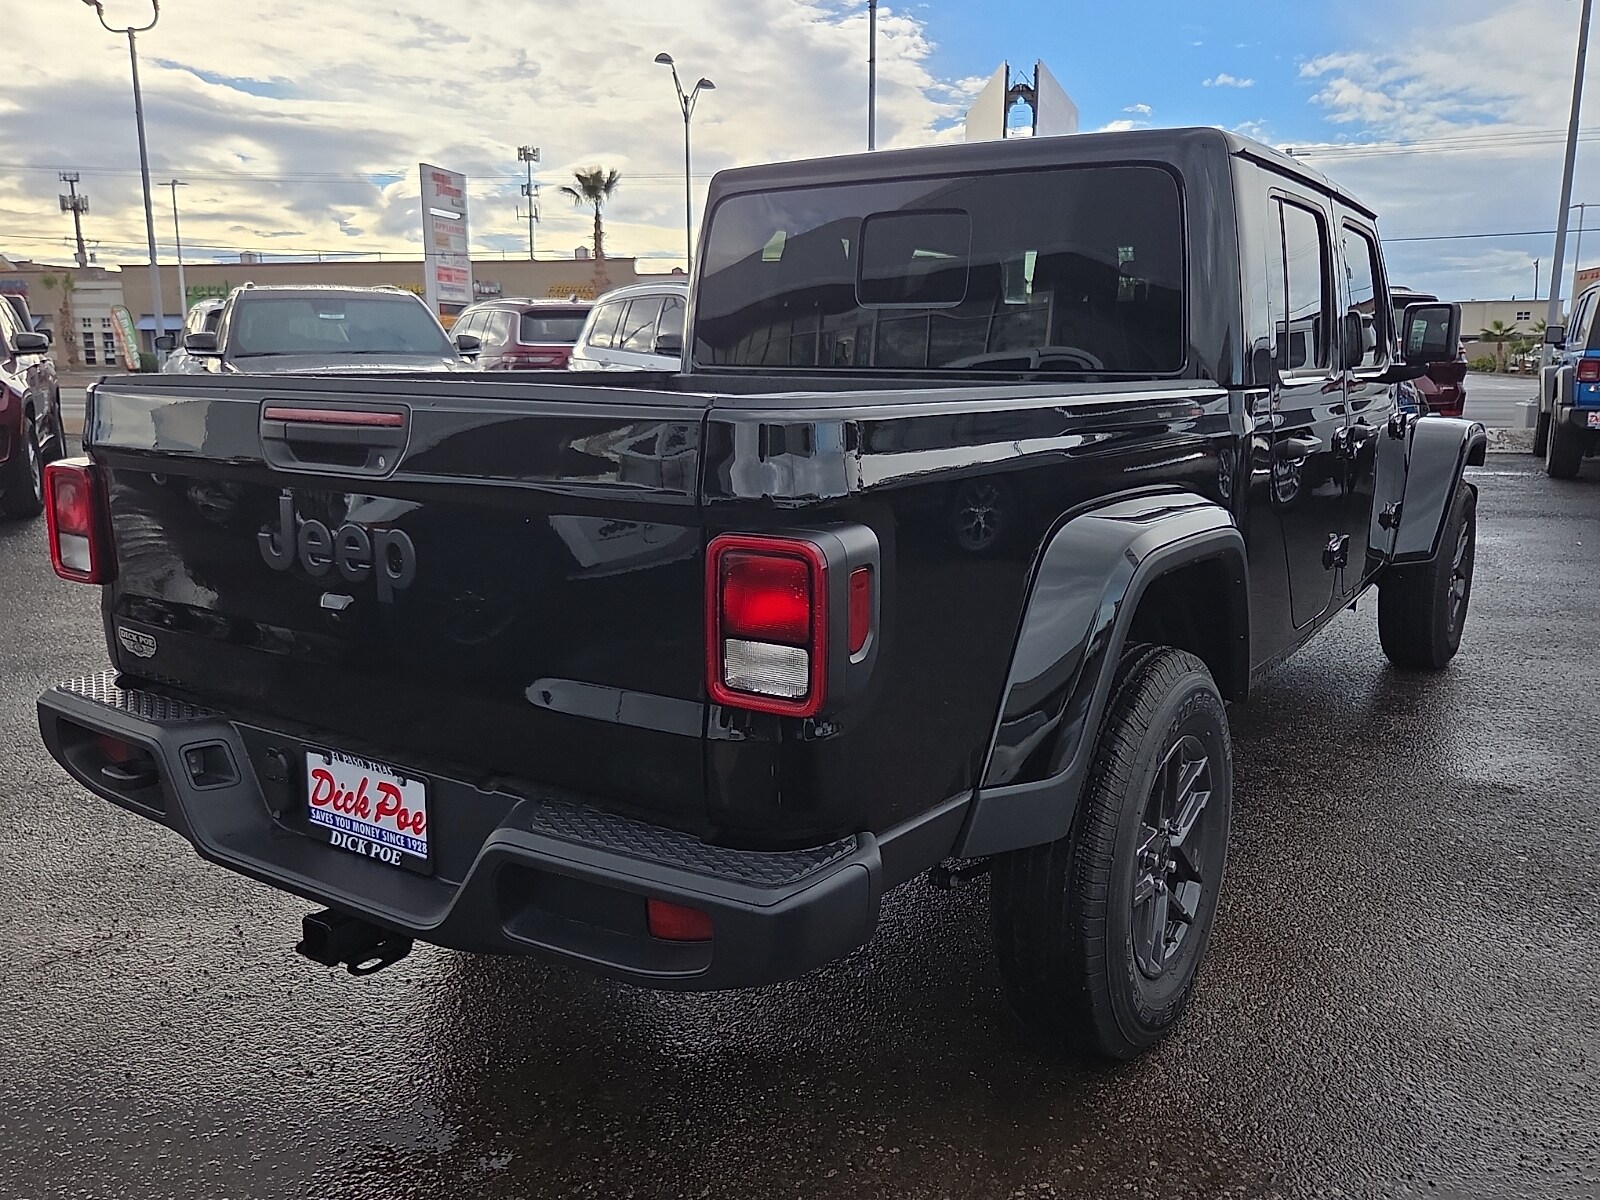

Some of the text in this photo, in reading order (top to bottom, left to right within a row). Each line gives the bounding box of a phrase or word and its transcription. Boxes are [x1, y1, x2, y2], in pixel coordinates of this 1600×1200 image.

[257, 496, 417, 603] Jeep
[120, 630, 154, 647] DICK POE
[369, 761, 394, 776] TEXAS
[311, 768, 426, 836] Dick Poe
[311, 809, 428, 853] SAVES YOU MONEY SINCE 1928
[330, 830, 402, 866] DICK POE
